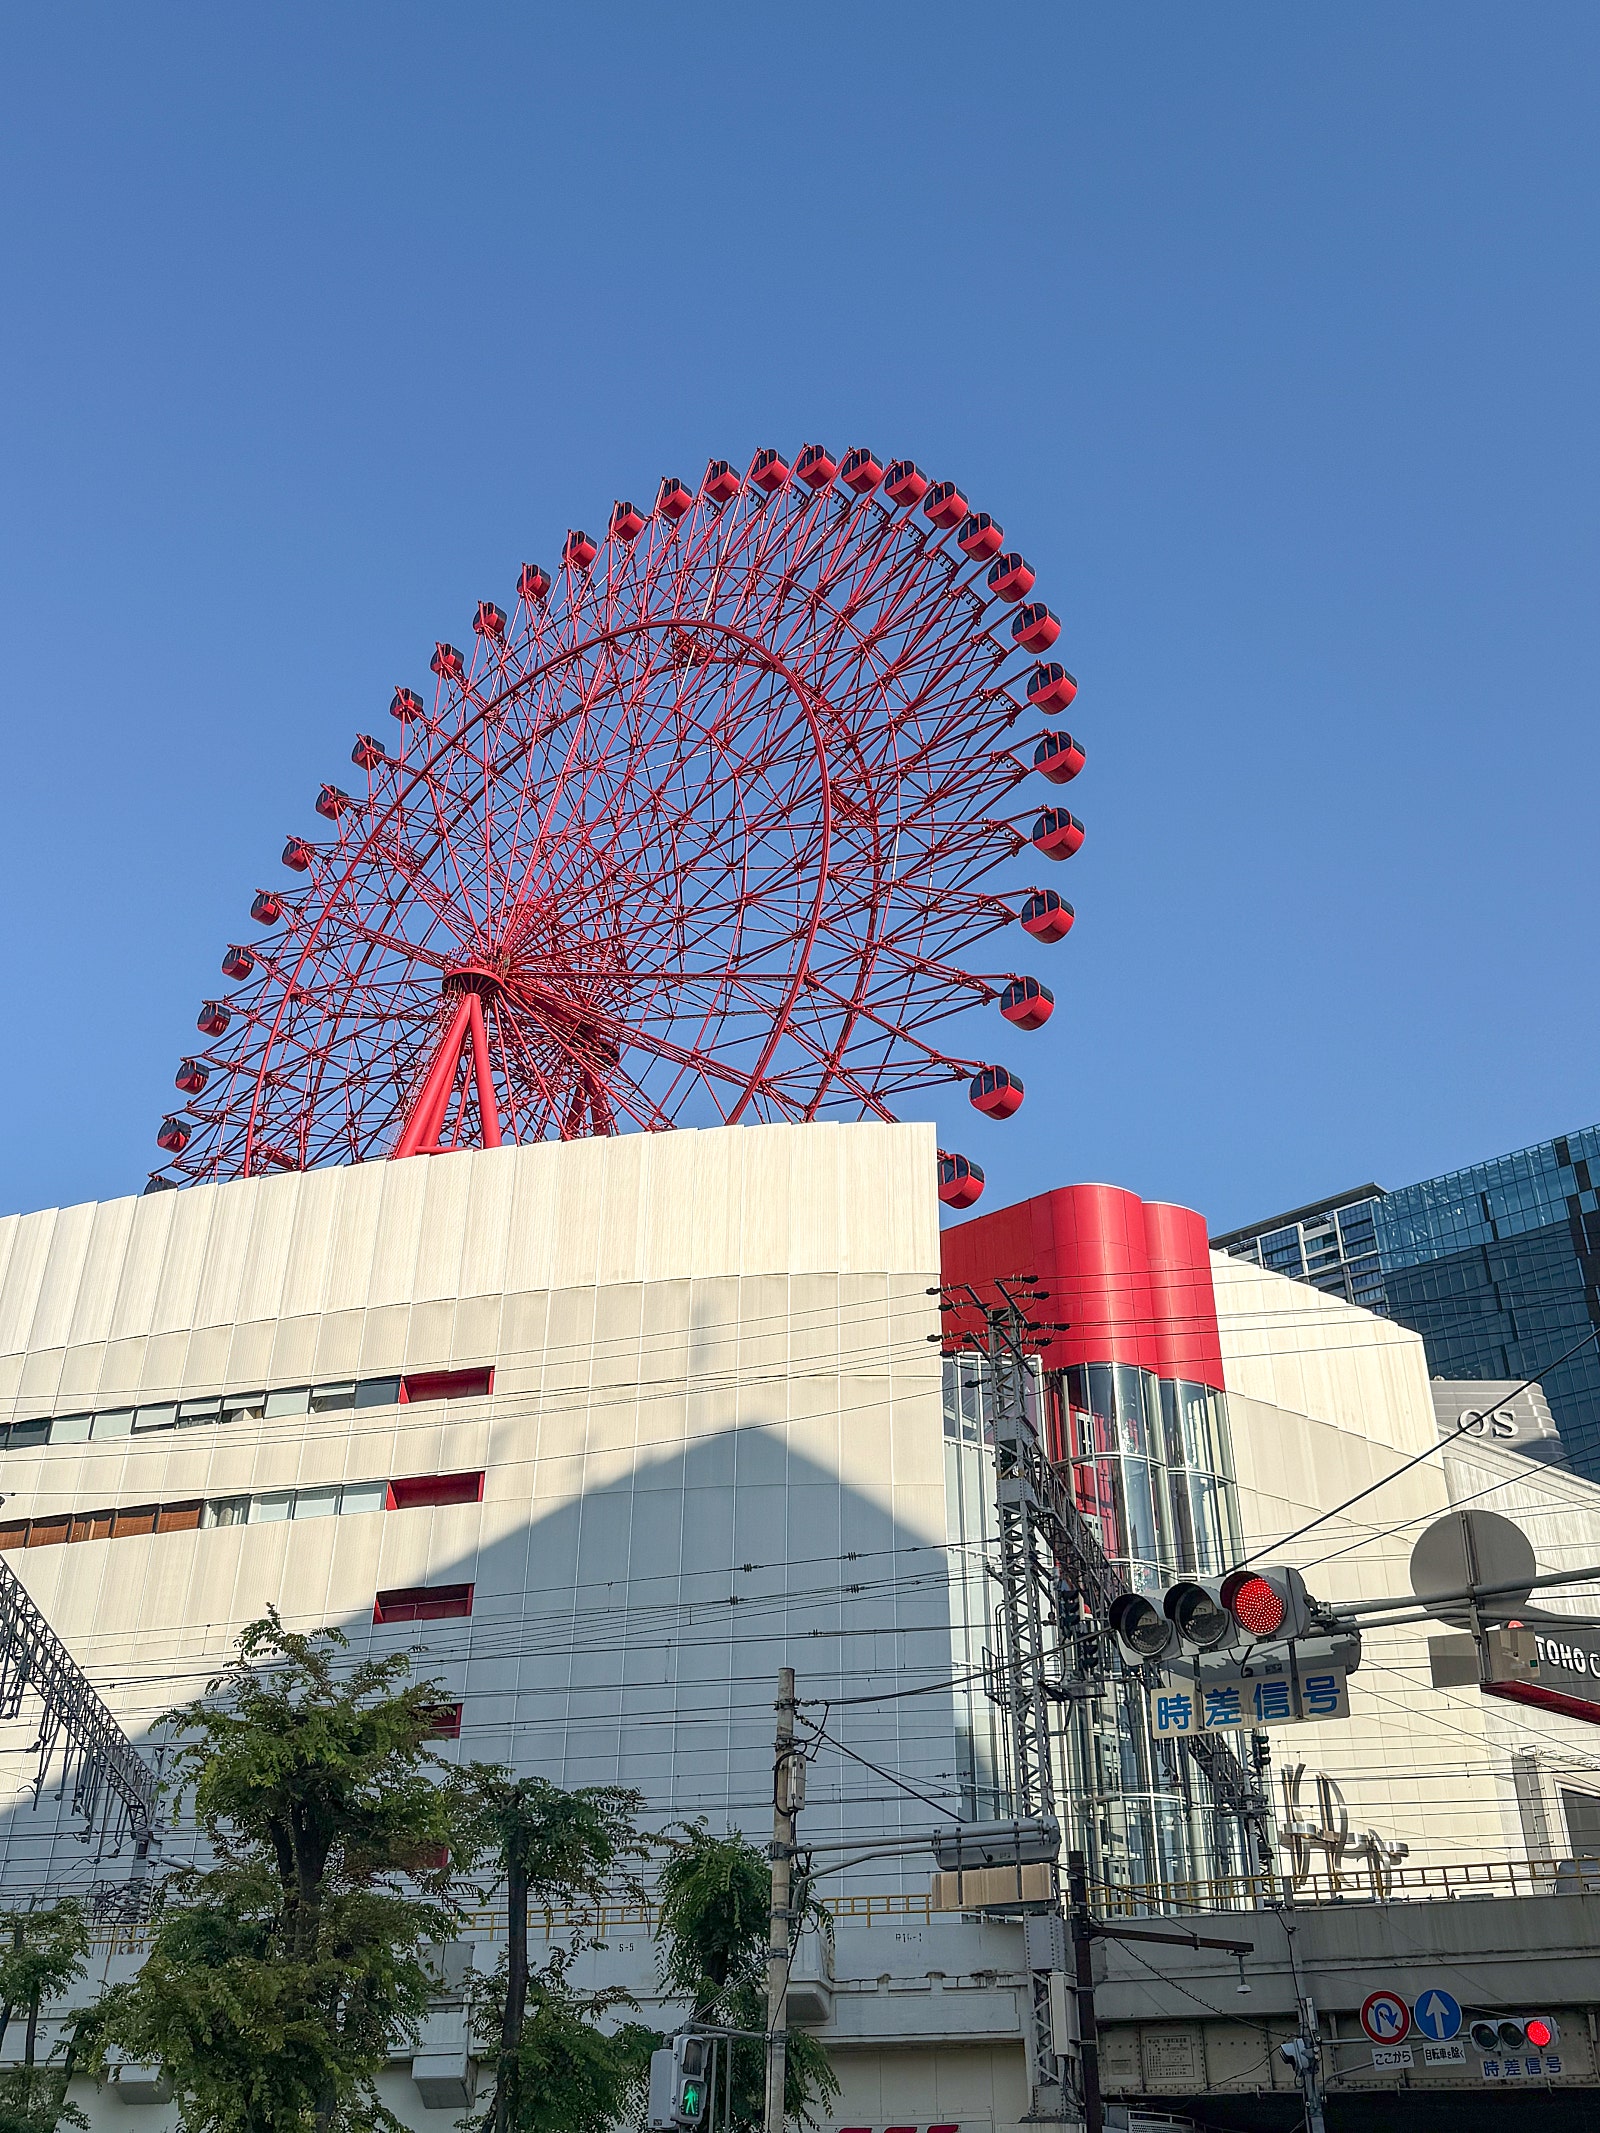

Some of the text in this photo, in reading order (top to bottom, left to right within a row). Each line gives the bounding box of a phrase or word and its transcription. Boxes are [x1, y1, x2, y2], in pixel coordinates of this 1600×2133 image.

[1457, 1409, 1518, 1438] OS
[1534, 1635, 1586, 1674] TOHO
[1157, 1674, 1341, 1731] 時差信号
[1374, 2050, 1412, 2066] ここから
[1424, 2046, 1465, 2061] 自転車を除く
[1483, 2056, 1562, 2077] 時差信号
